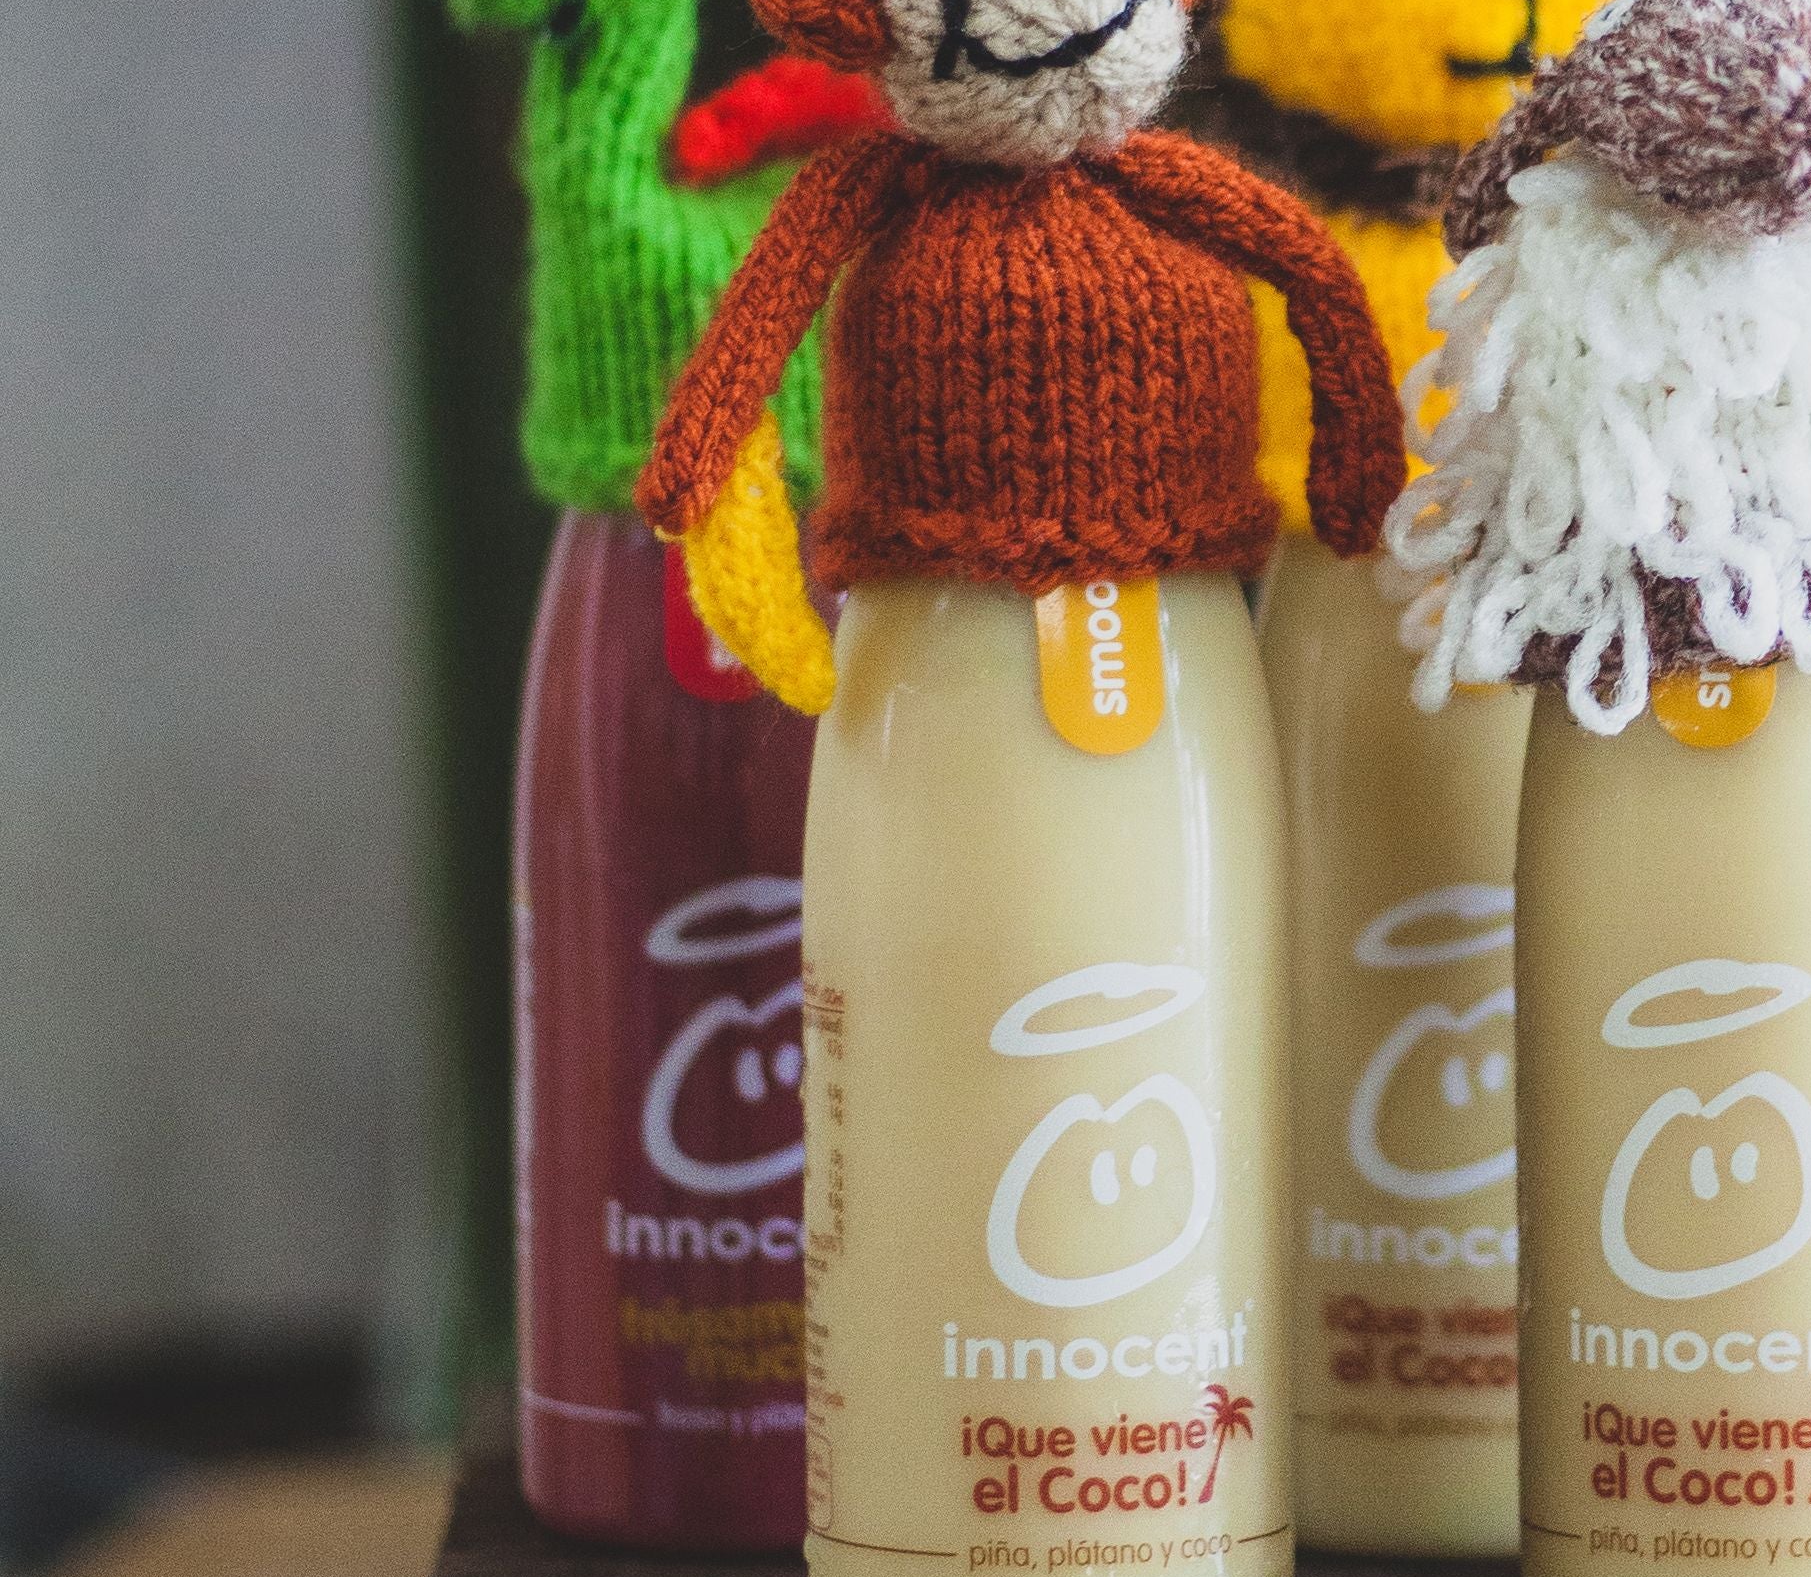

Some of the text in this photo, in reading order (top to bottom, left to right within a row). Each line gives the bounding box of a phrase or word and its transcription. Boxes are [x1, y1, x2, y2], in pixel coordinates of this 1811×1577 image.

[1085, 580, 1129, 716] smoo
[607, 1196, 804, 1262] innoc
[943, 1311, 1247, 1380] innocent
[1390, 1342, 1517, 1387] Coco
[961, 1413, 1207, 1459] ¡Que viene
[1583, 1401, 1677, 1449] ¡Que
[972, 1460, 1187, 1514] el Coco!
[1591, 1450, 1795, 1506] el Coco!
[968, 1533, 1232, 1571] piña, plátano y coco
[1589, 1526, 1645, 1557] piña,
[1653, 1530, 1757, 1561] plátano
[1765, 1538, 1781, 1564] y
